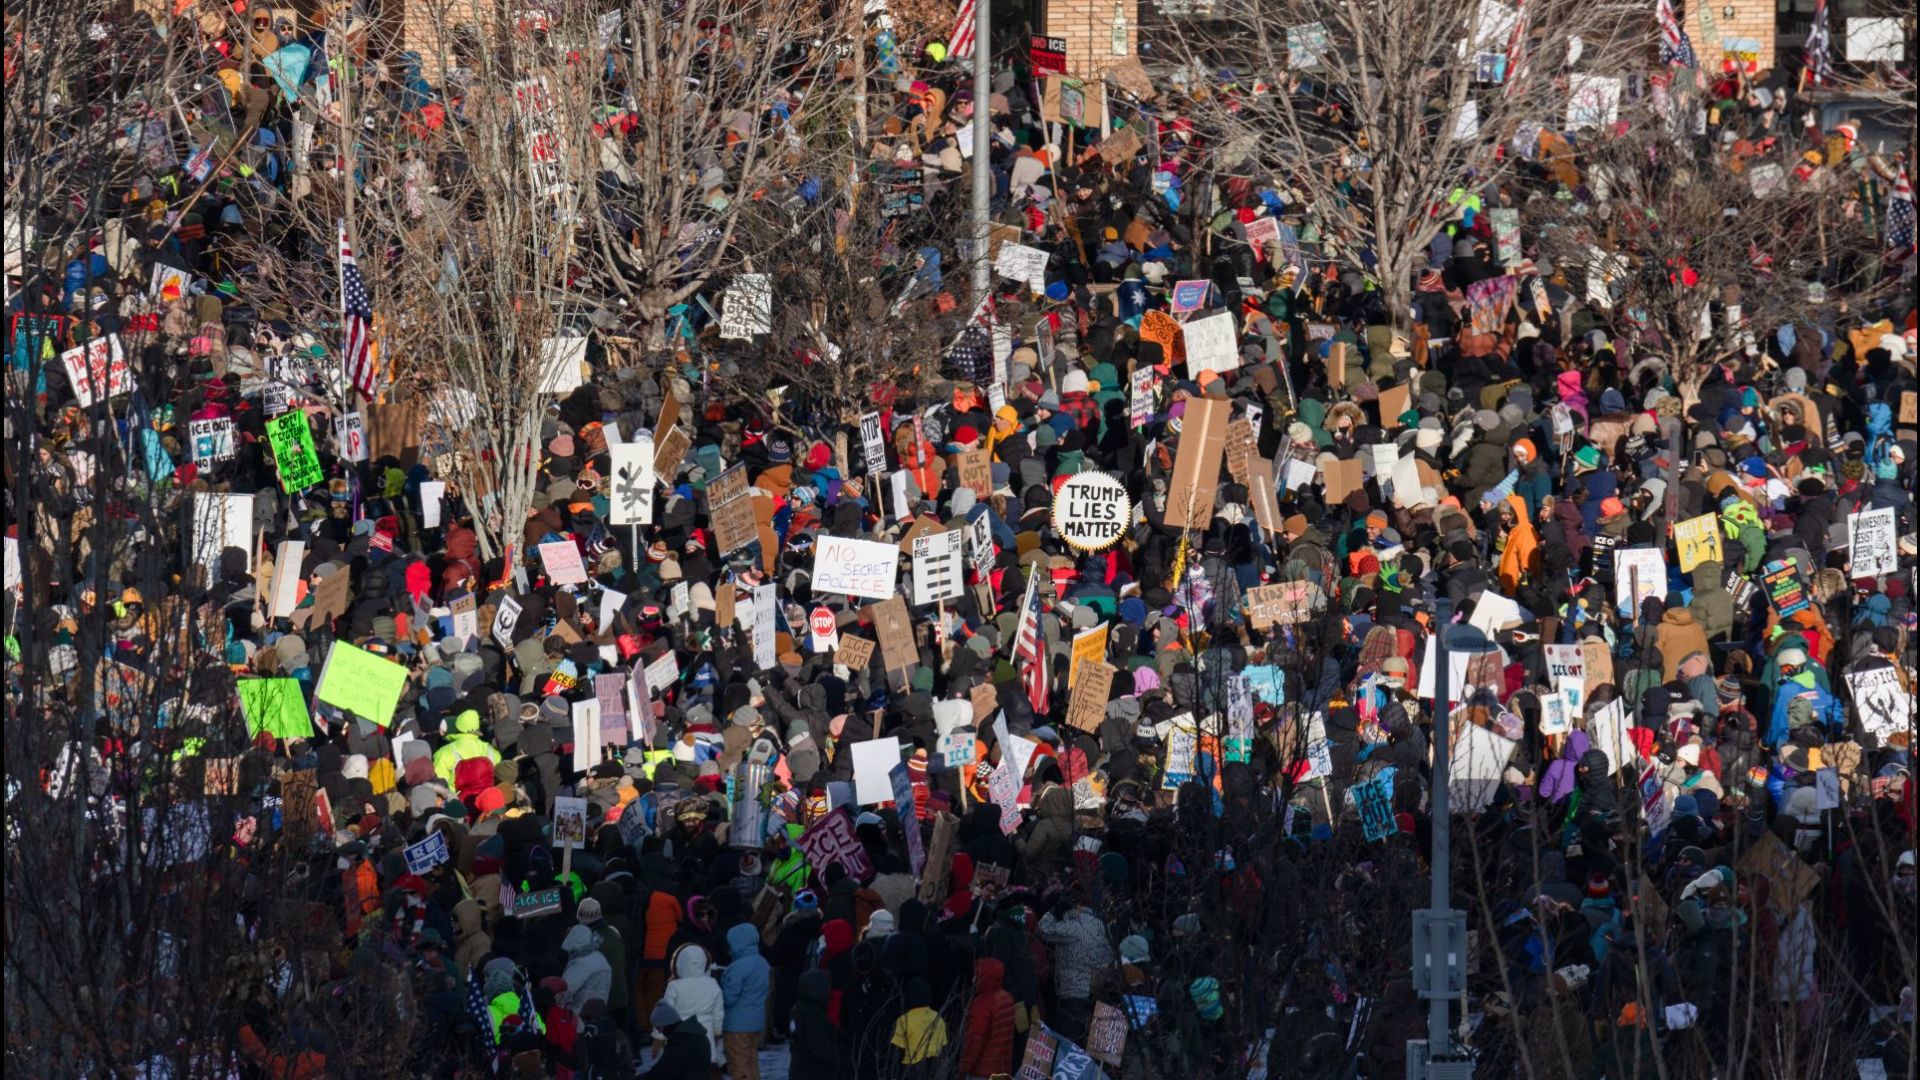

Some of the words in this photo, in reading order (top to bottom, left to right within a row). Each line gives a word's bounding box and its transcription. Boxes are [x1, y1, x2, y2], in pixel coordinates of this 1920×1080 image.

[1031, 36, 1047, 49] NO
[1048, 38, 1066, 51] ICE
[191, 421, 211, 437] ICE
[211, 418, 232, 433] OUT
[861, 415, 880, 442] STOP
[195, 457, 210, 470] NO
[965, 454, 980, 465] ICE
[963, 465, 987, 481] OUT
[1066, 485, 1125, 502] TRUMP
[1069, 502, 1116, 520] LIES
[1064, 521, 1122, 538] MATTER
[1675, 520, 1699, 540] MELT
[1701, 516, 1716, 533] ICE
[825, 544, 857, 563] NO
[841, 560, 892, 578] SECRET
[818, 572, 886, 593] POLICE
[455, 599, 470, 611] ICE
[814, 615, 833, 629] STOP
[844, 636, 871, 654] ICE
[839, 650, 868, 666] OUT!
[551, 671, 571, 685] ICE
[1552, 664, 1568, 676] ICE
[1568, 664, 1582, 676] OUT
[1881, 668, 1897, 685] ICE
[949, 748, 969, 763] ICE
[1356, 780, 1384, 801] ICE
[808, 817, 853, 866] ICE
[411, 846, 426, 860] ICE
[540, 888, 561, 904] ICE
